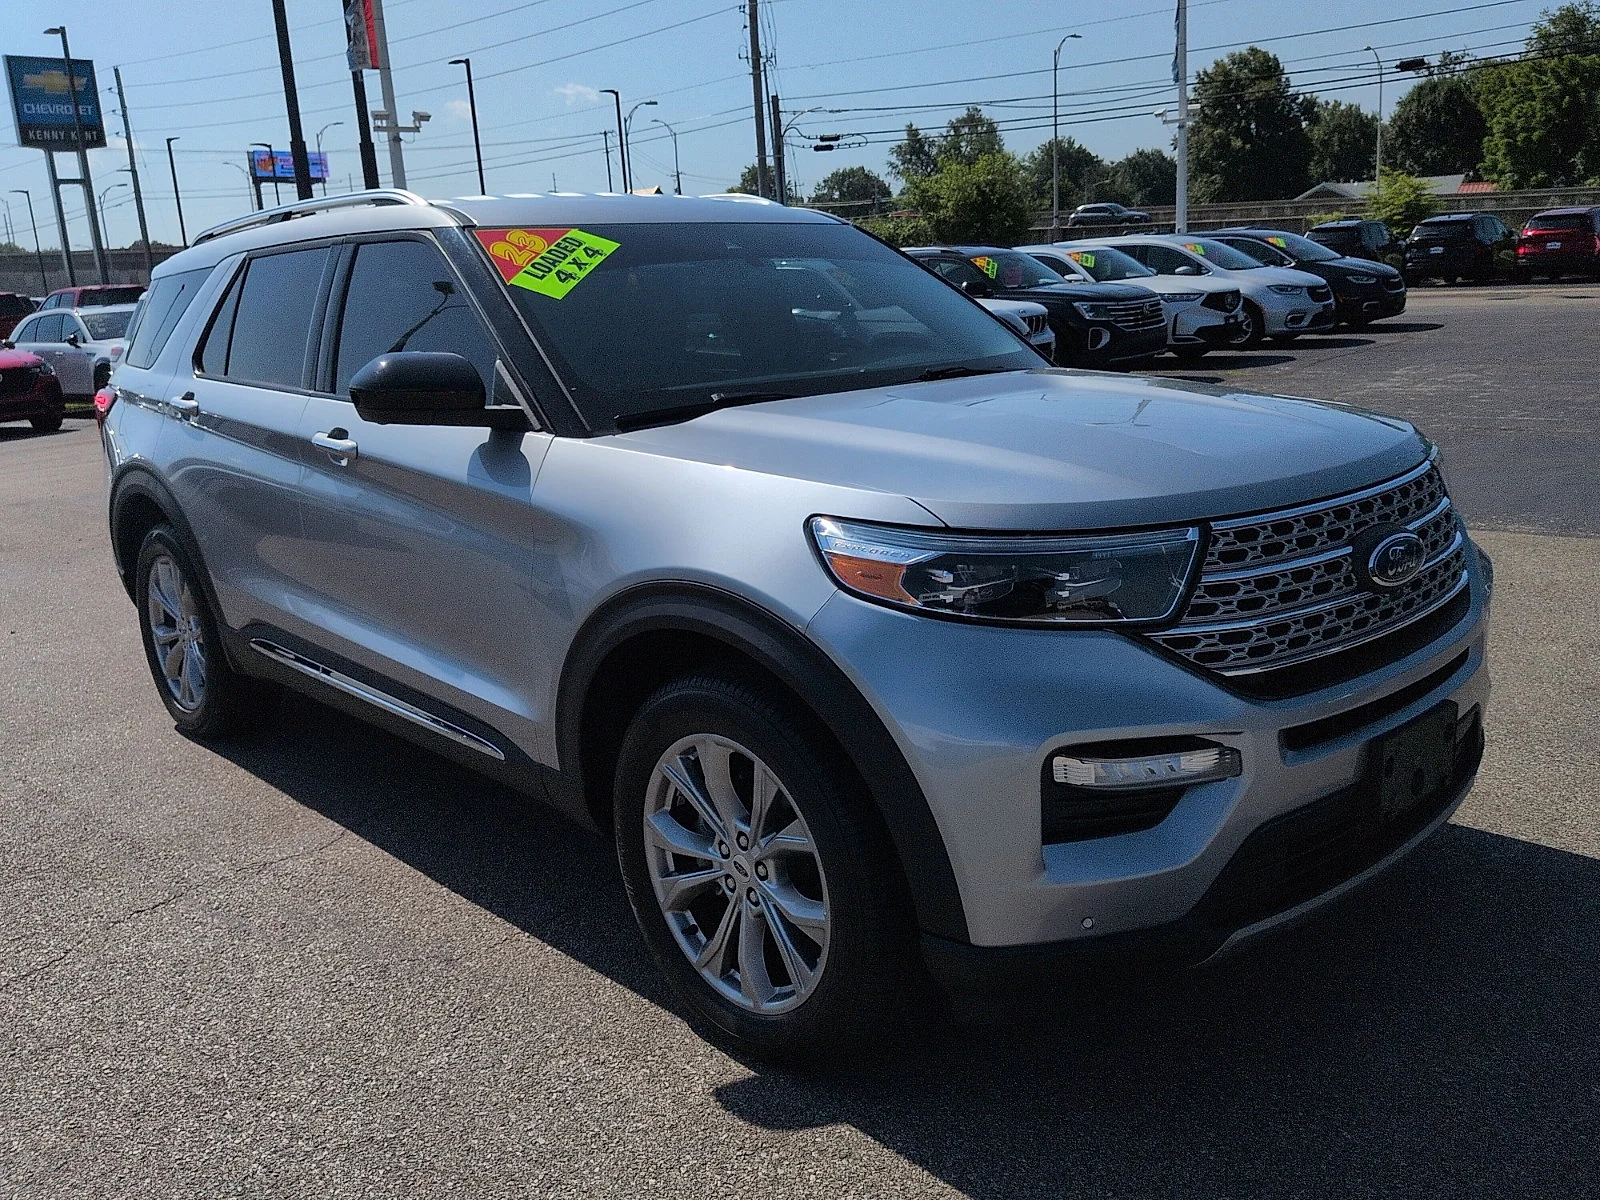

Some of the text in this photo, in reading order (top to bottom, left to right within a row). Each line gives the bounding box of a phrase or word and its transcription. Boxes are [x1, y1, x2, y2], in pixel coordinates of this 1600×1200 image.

[23, 103, 94, 115] CHEVROET
[28, 129, 97, 141] KENNY KNT
[489, 230, 548, 267] 23
[523, 236, 586, 280] LOADED
